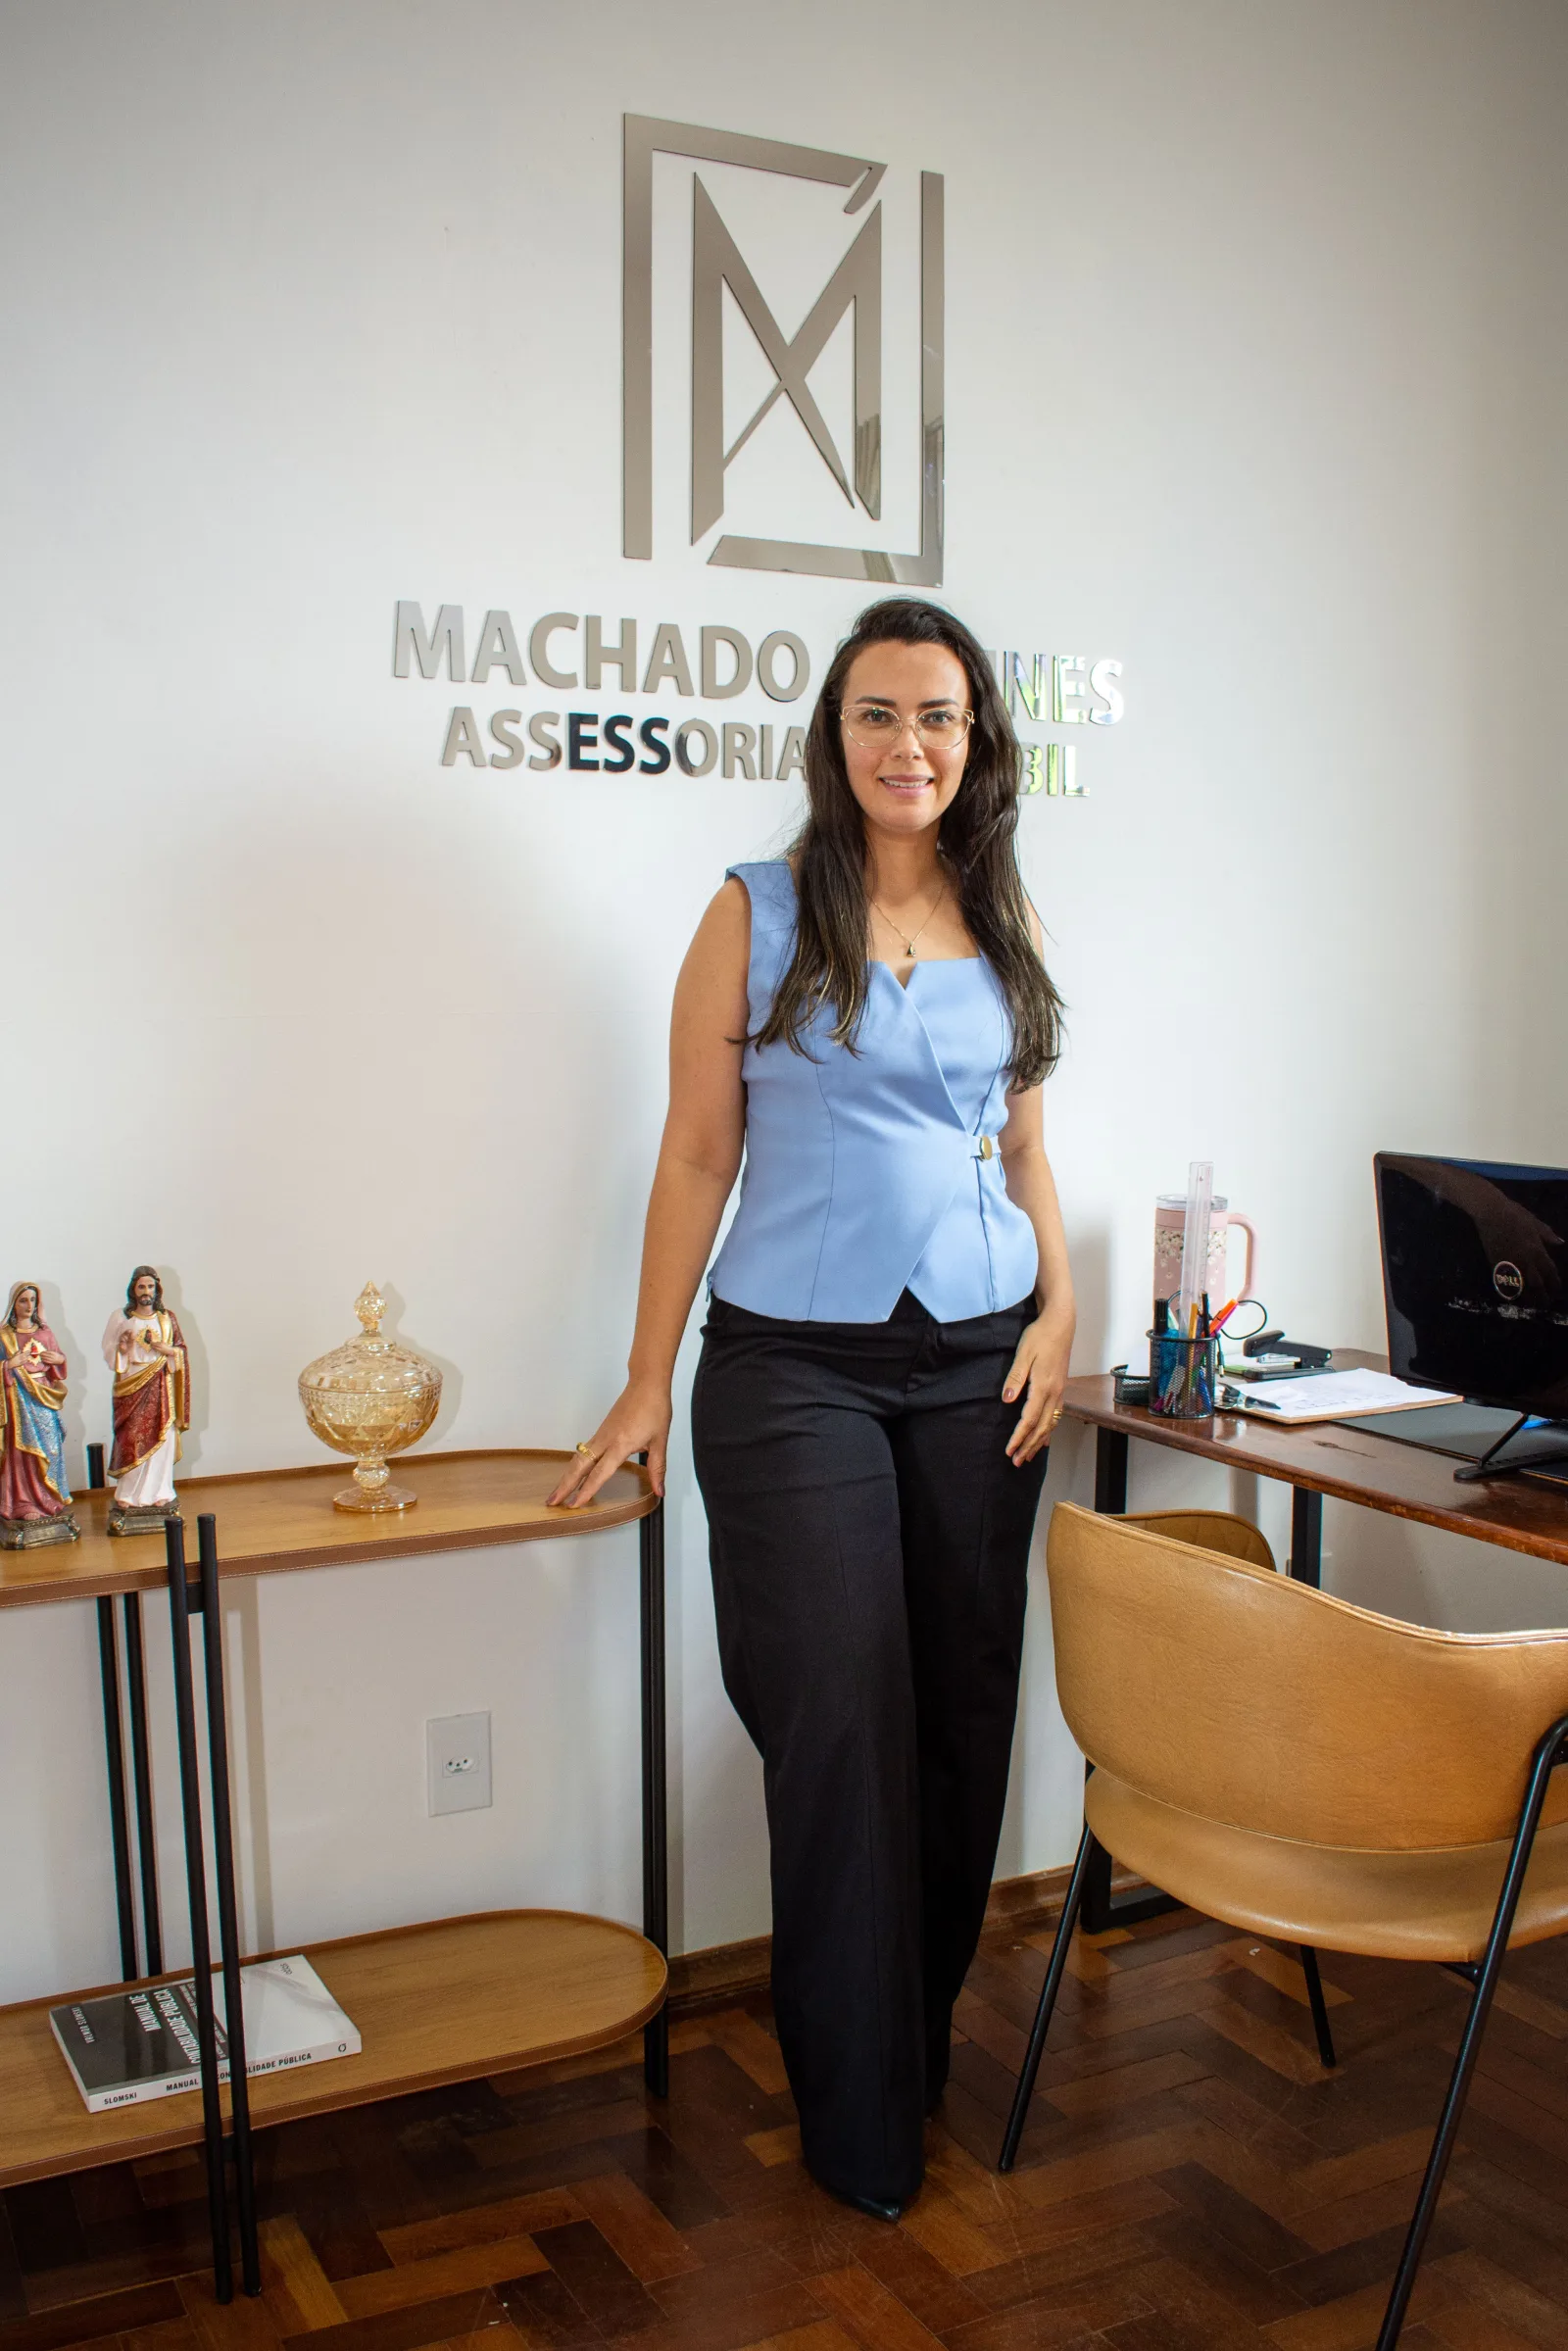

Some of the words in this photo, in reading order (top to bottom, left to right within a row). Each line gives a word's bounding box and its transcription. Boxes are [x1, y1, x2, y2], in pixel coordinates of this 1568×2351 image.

[393, 600, 810, 703] MACHADO
[441, 706, 809, 782] ASSESSORIA
[1495, 1274, 1521, 1288] DELL
[129, 1993, 148, 2005] DE
[154, 1988, 181, 2017] PÚBLICA
[134, 2002, 162, 2033] MANUAL
[104, 2092, 137, 2105] SLOMSKI
[166, 2079, 199, 2091] MANUAL
[278, 2052, 312, 2067] PÚBLICA
